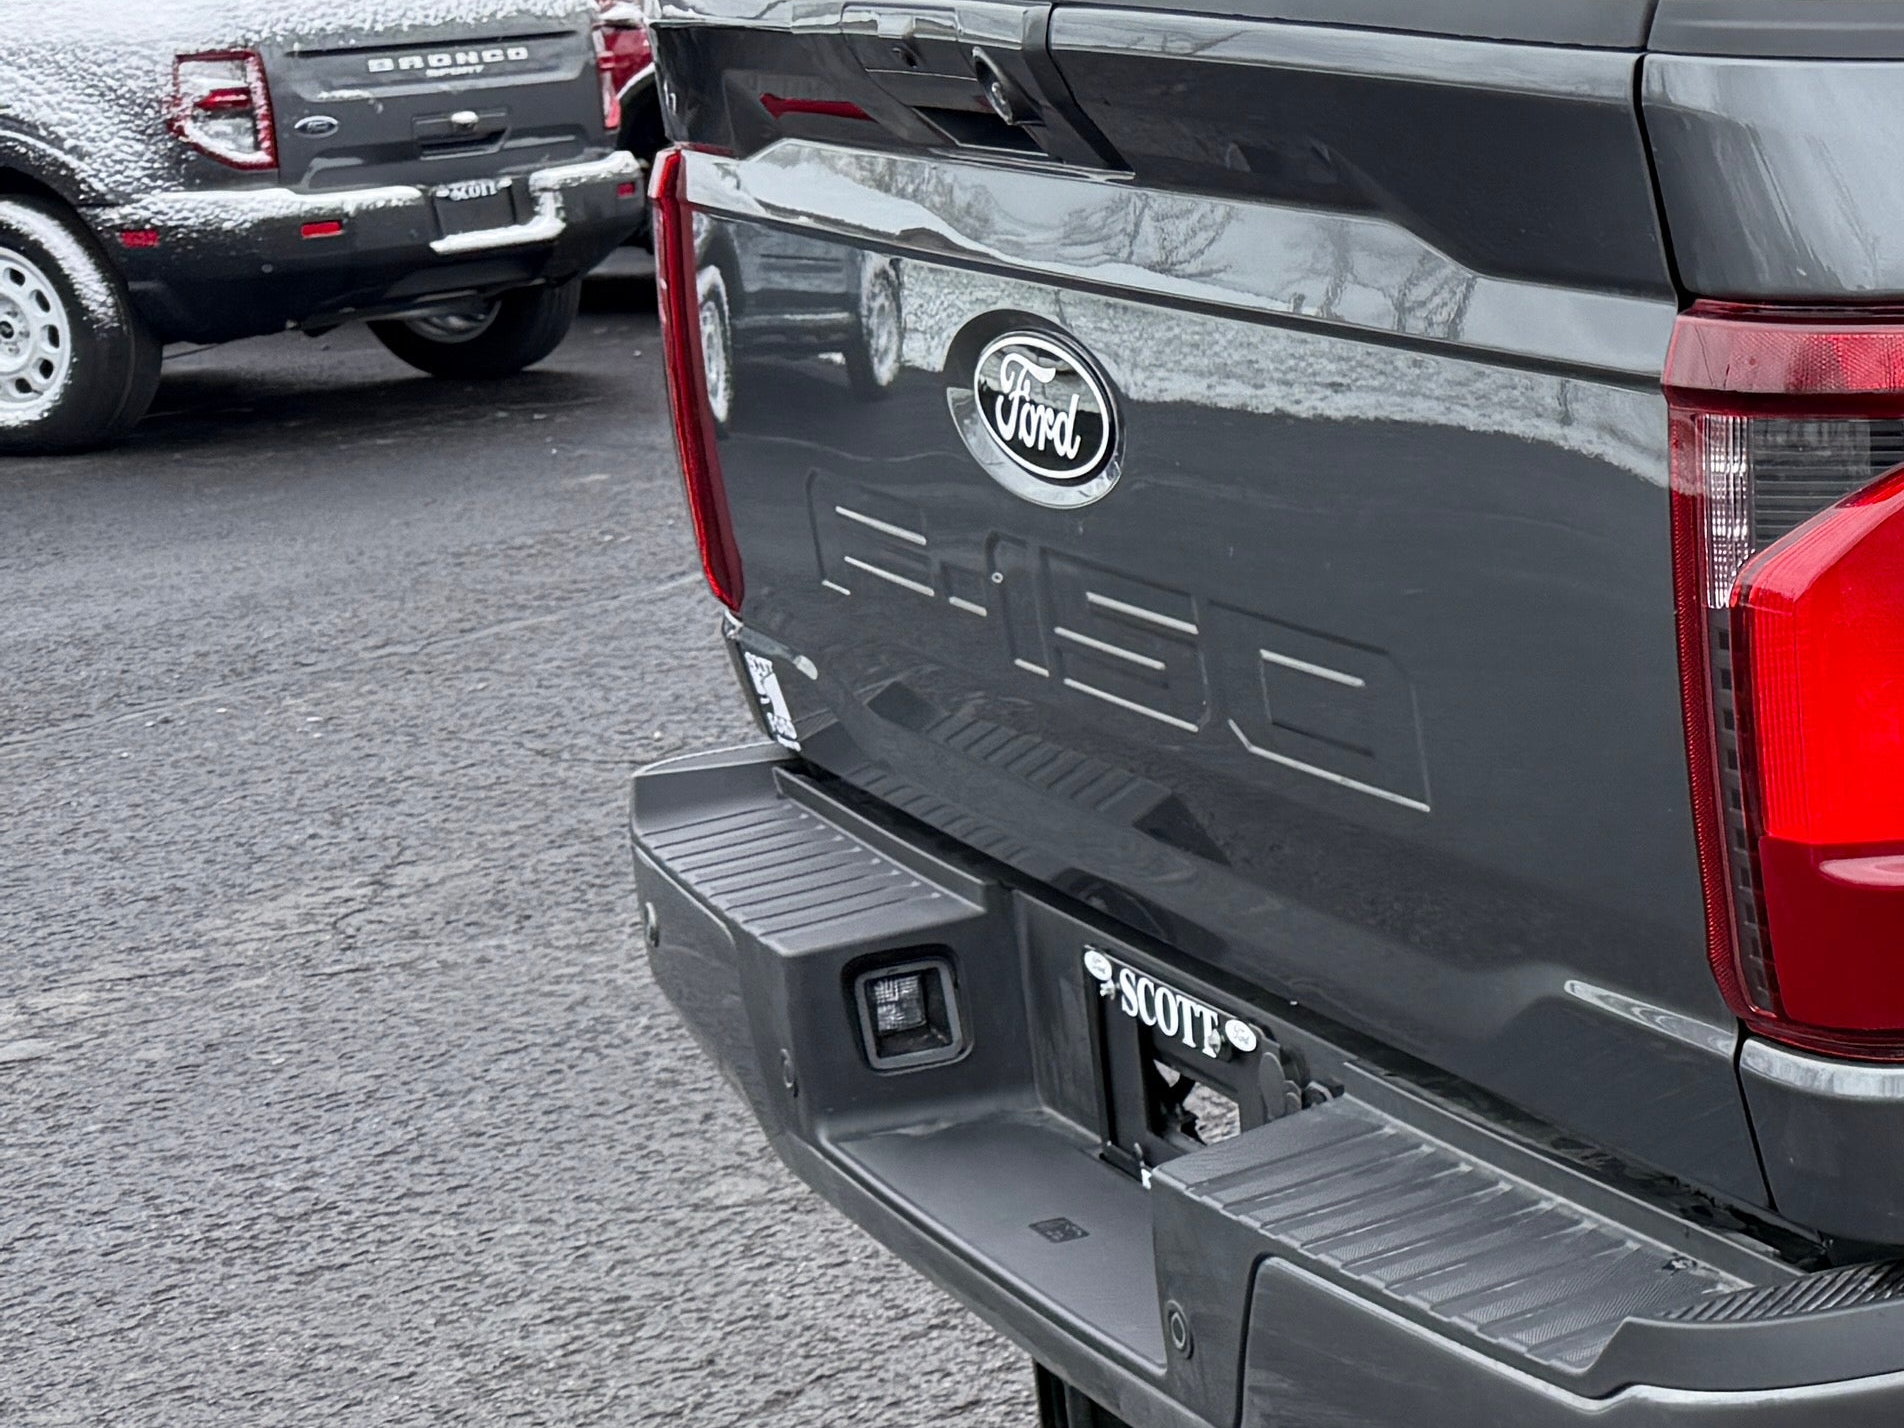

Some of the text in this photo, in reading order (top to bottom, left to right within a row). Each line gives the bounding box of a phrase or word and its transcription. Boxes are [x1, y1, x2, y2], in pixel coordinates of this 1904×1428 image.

[367, 47, 528, 72] BRONCO
[995, 352, 1081, 460] Ford
[1119, 968, 1219, 1059] SCOTT
